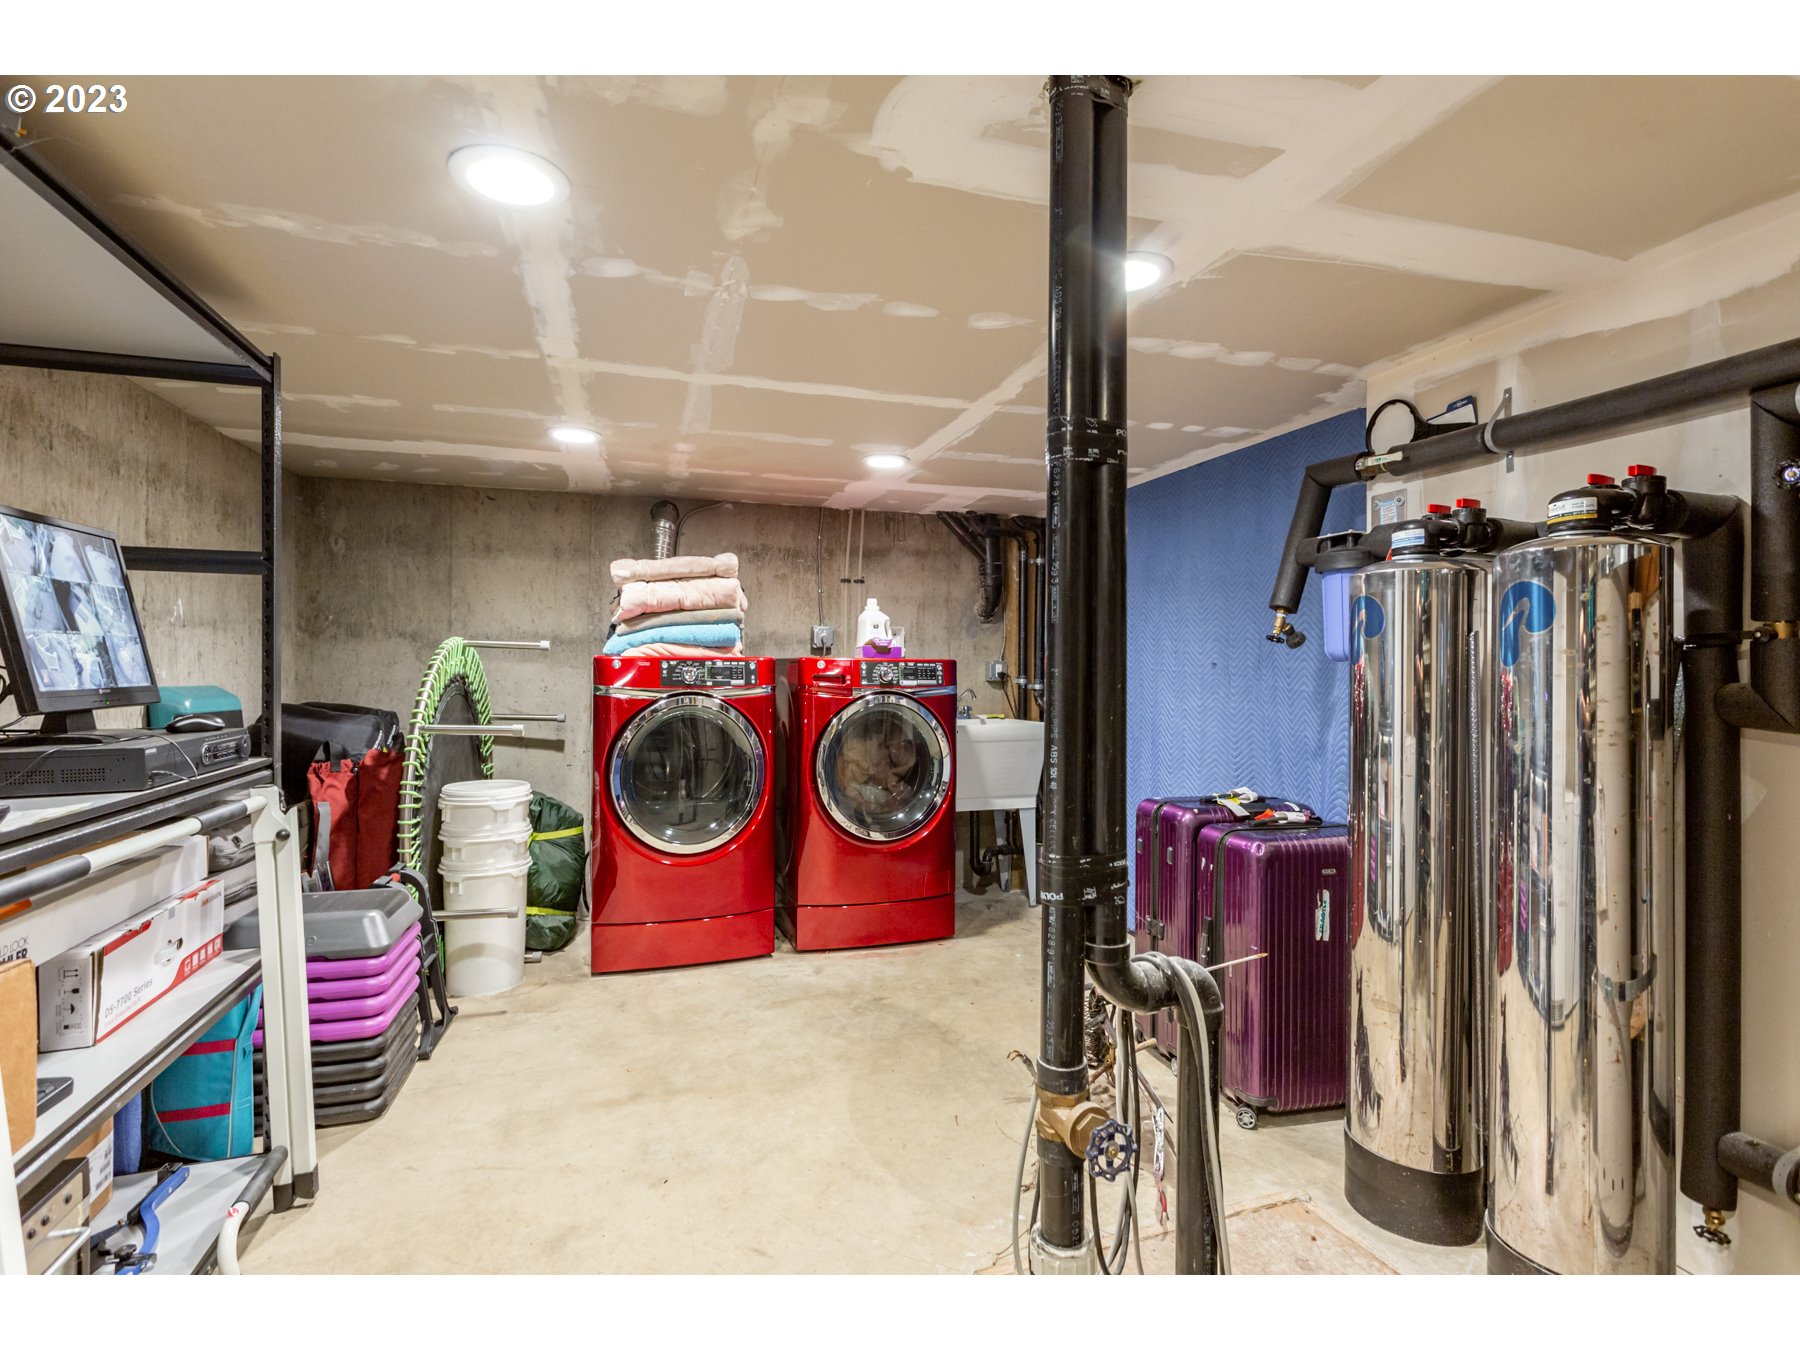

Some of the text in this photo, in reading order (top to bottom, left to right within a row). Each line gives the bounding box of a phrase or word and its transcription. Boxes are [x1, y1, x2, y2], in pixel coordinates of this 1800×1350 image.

[1050, 744, 1059, 763] ABS
[104, 990, 132, 1018] DS-7700
[133, 977, 153, 998] Series
